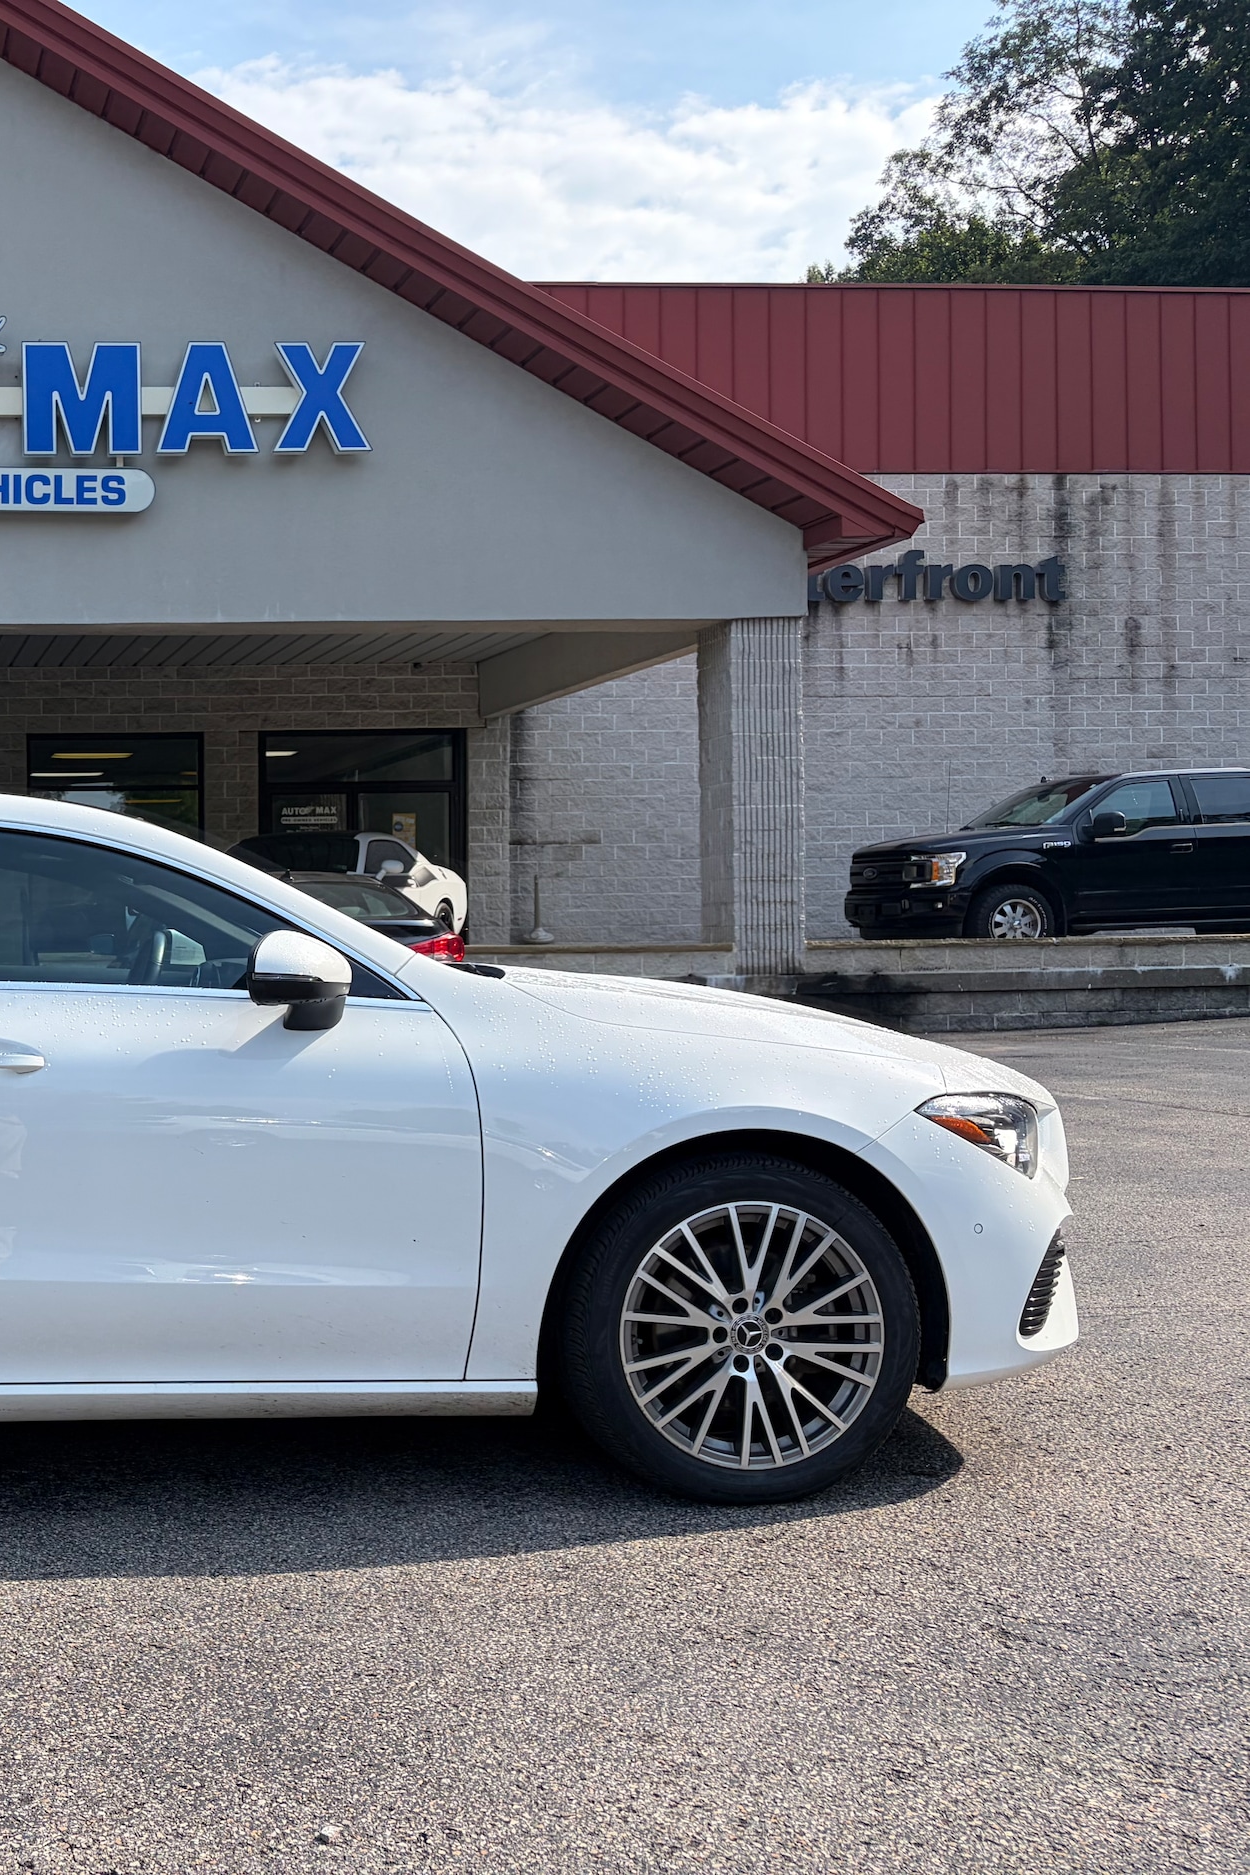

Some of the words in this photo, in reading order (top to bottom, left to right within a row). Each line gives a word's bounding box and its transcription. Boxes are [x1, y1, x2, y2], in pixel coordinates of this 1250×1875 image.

[21, 340, 373, 456] MAX
[281, 807, 307, 815] AUTO
[315, 806, 337, 814] MAX
